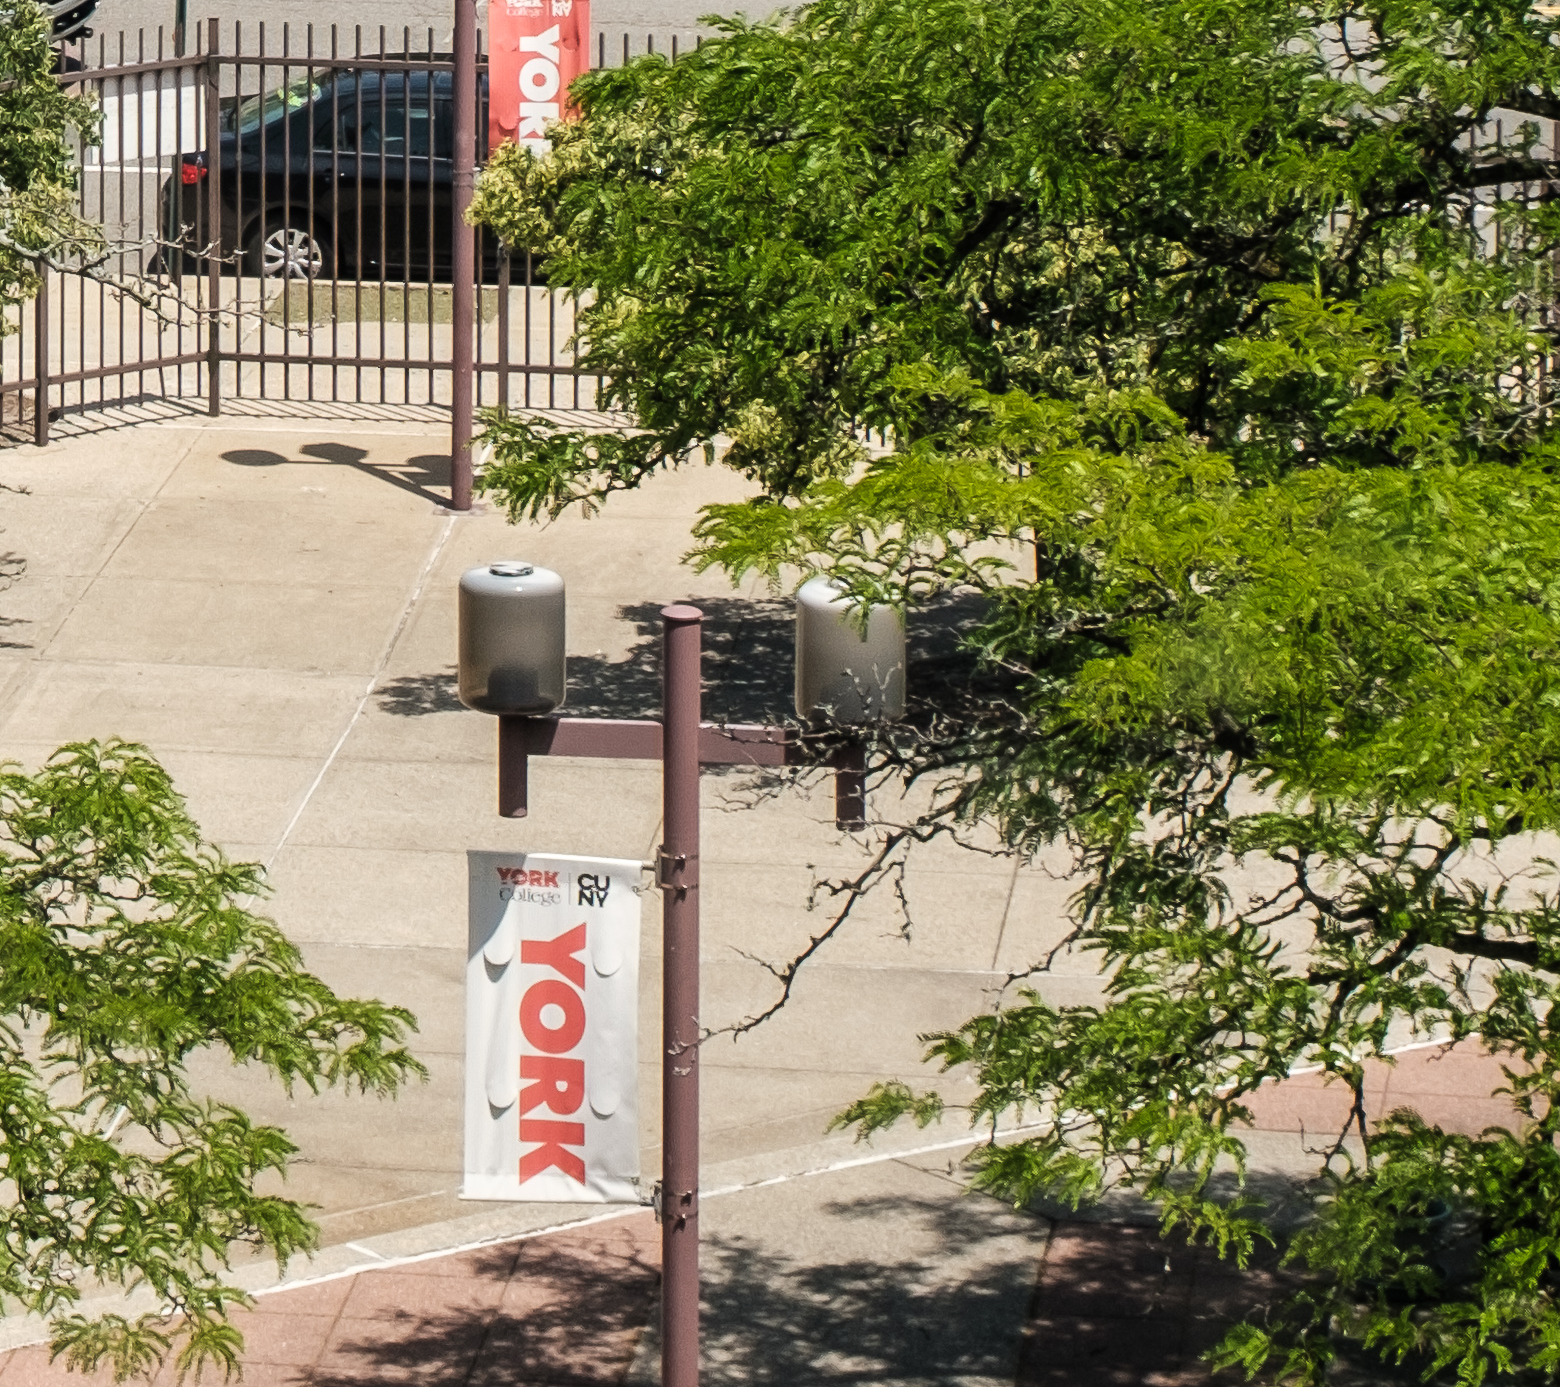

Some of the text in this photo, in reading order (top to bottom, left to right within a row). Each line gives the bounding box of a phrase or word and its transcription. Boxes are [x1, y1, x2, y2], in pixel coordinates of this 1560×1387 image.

[497, 867, 560, 888] YORK
[499, 887, 561, 907] College
[519, 921, 587, 1186] YORK
